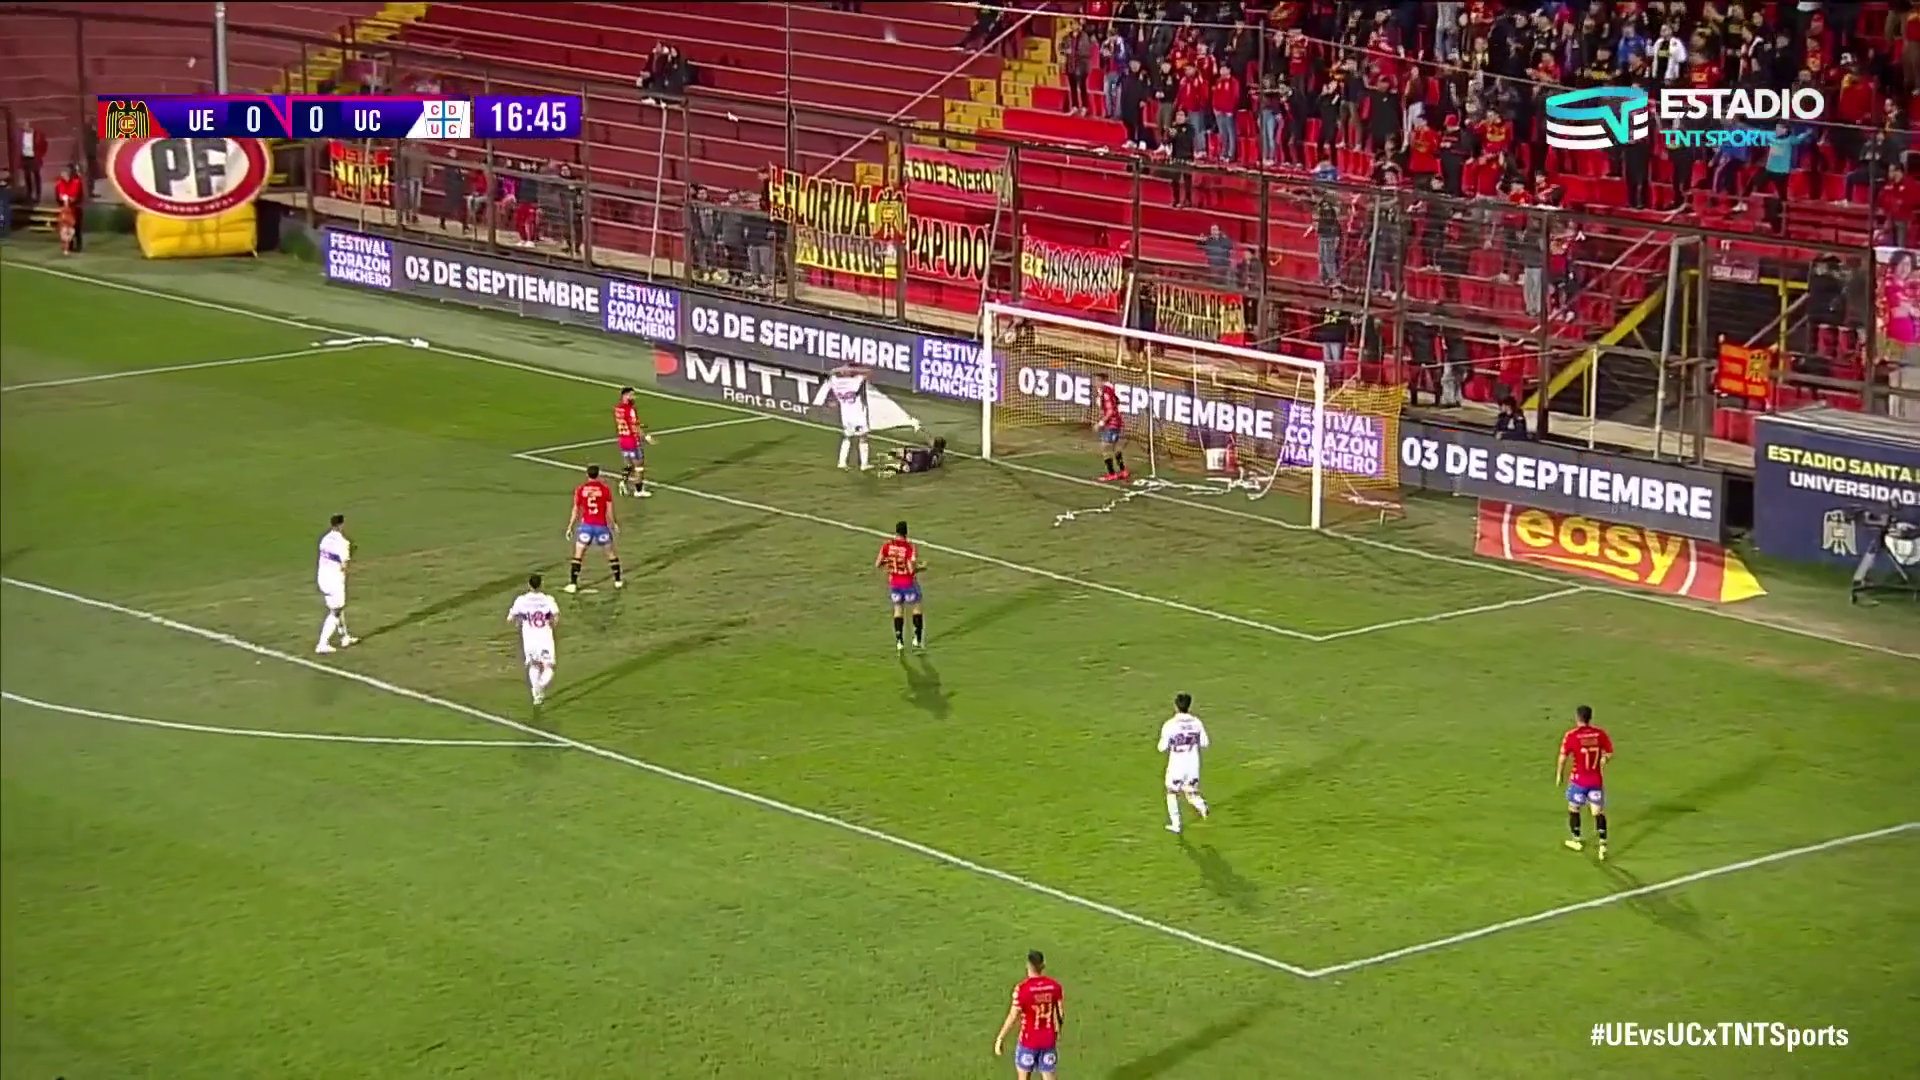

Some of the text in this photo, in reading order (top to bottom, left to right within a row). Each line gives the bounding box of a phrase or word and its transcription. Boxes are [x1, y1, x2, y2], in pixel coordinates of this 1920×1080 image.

[151, 138, 228, 197] PF
[945, 161, 994, 194] ENERO
[783, 169, 872, 238] FLORIDA
[330, 233, 389, 257] FESTIVAL
[909, 215, 989, 280] PAPUDO
[330, 264, 391, 287] RANCHERO
[405, 255, 600, 313] 03 DE SEPTIEMBRE
[609, 281, 674, 308] FESTIVAL
[607, 299, 675, 326] CORAZÓN
[607, 315, 675, 340] RANCHERO
[691, 306, 911, 373] 03 DE SEPTIEMBRE
[723, 386, 809, 416] Rent a Car
[1018, 366, 1274, 440] 03 DE EPTIEMBRE
[1401, 437, 1713, 520] 03 DE SEPTIEMBRE
[1767, 444, 1846, 472] ESTADIO
[1848, 459, 1913, 483] SANTA
[1789, 470, 1915, 505] UNIVERSIDAD
[587, 497, 599, 515] 5
[1515, 509, 1684, 585] easy
[526, 611, 546, 628] 18
[1580, 747, 1600, 770] 17
[1031, 1003, 1052, 1030] 14
